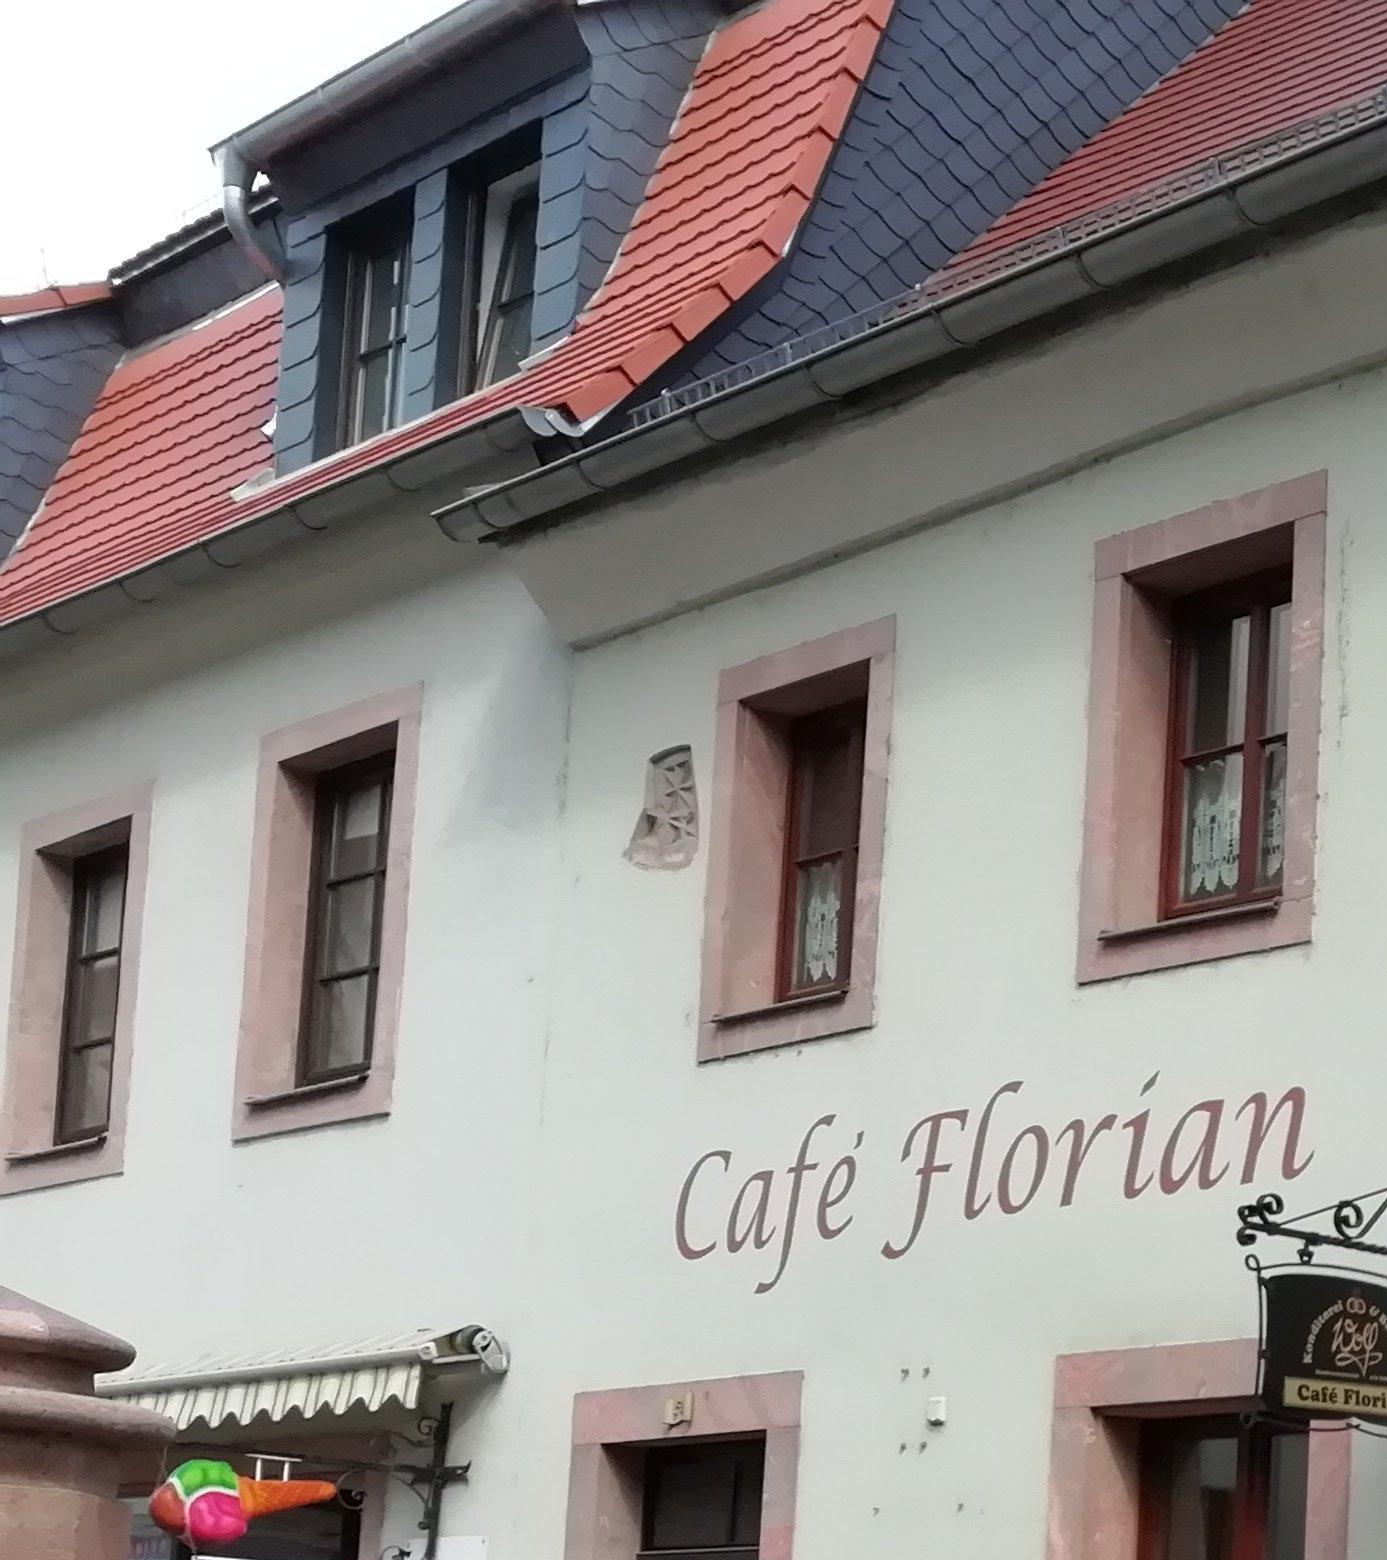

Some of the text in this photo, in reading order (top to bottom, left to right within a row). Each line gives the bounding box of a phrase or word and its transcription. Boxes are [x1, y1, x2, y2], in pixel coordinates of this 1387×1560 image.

[674, 1071, 1314, 1294] Café Florian
[1297, 1383, 1338, 1405] Café
